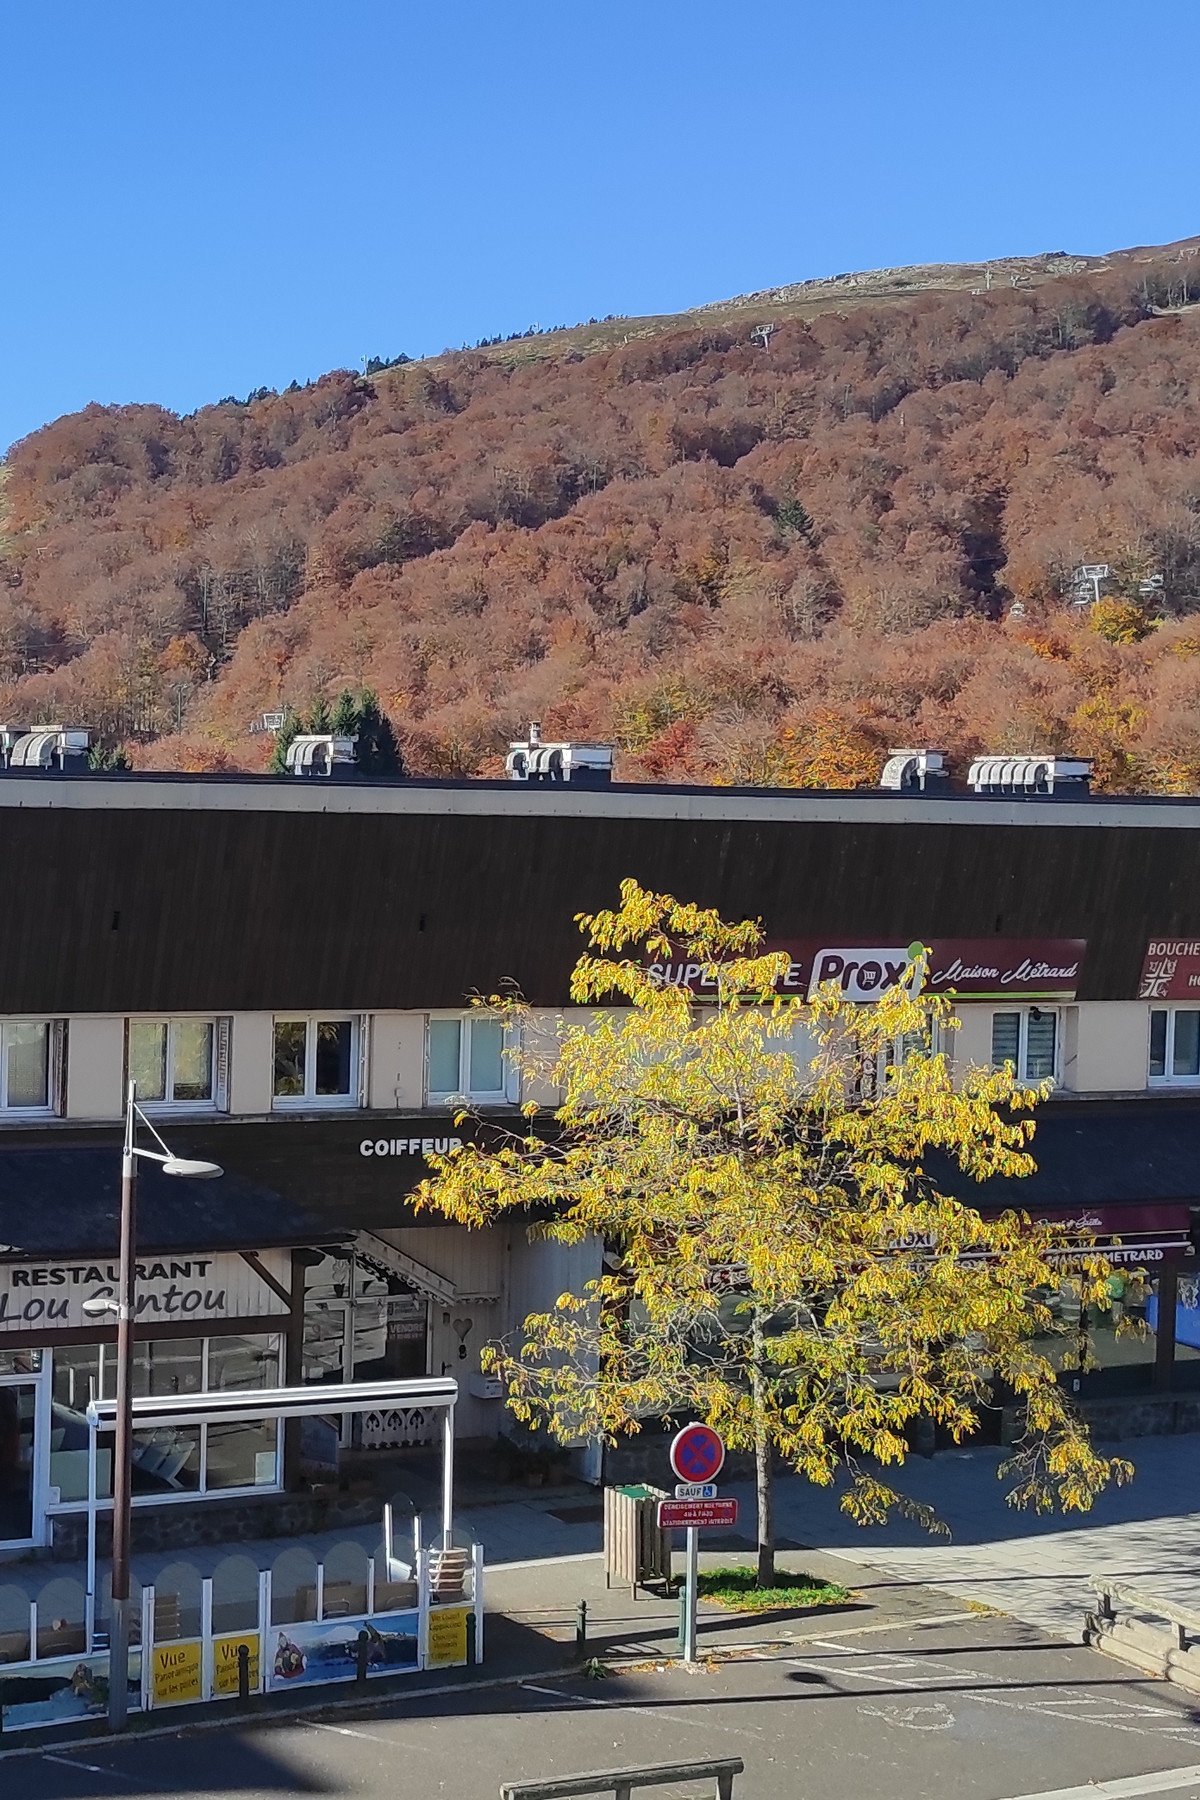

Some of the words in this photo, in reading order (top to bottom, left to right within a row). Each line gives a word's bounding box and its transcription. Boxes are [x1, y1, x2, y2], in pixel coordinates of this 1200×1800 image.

[1148, 942, 1200, 956] BOUCHE
[931, 957, 999, 985] Maison
[1000, 957, 1079, 985] Métrard
[680, 1487, 702, 1496] SAUF
[160, 1651, 186, 1669] Vue
